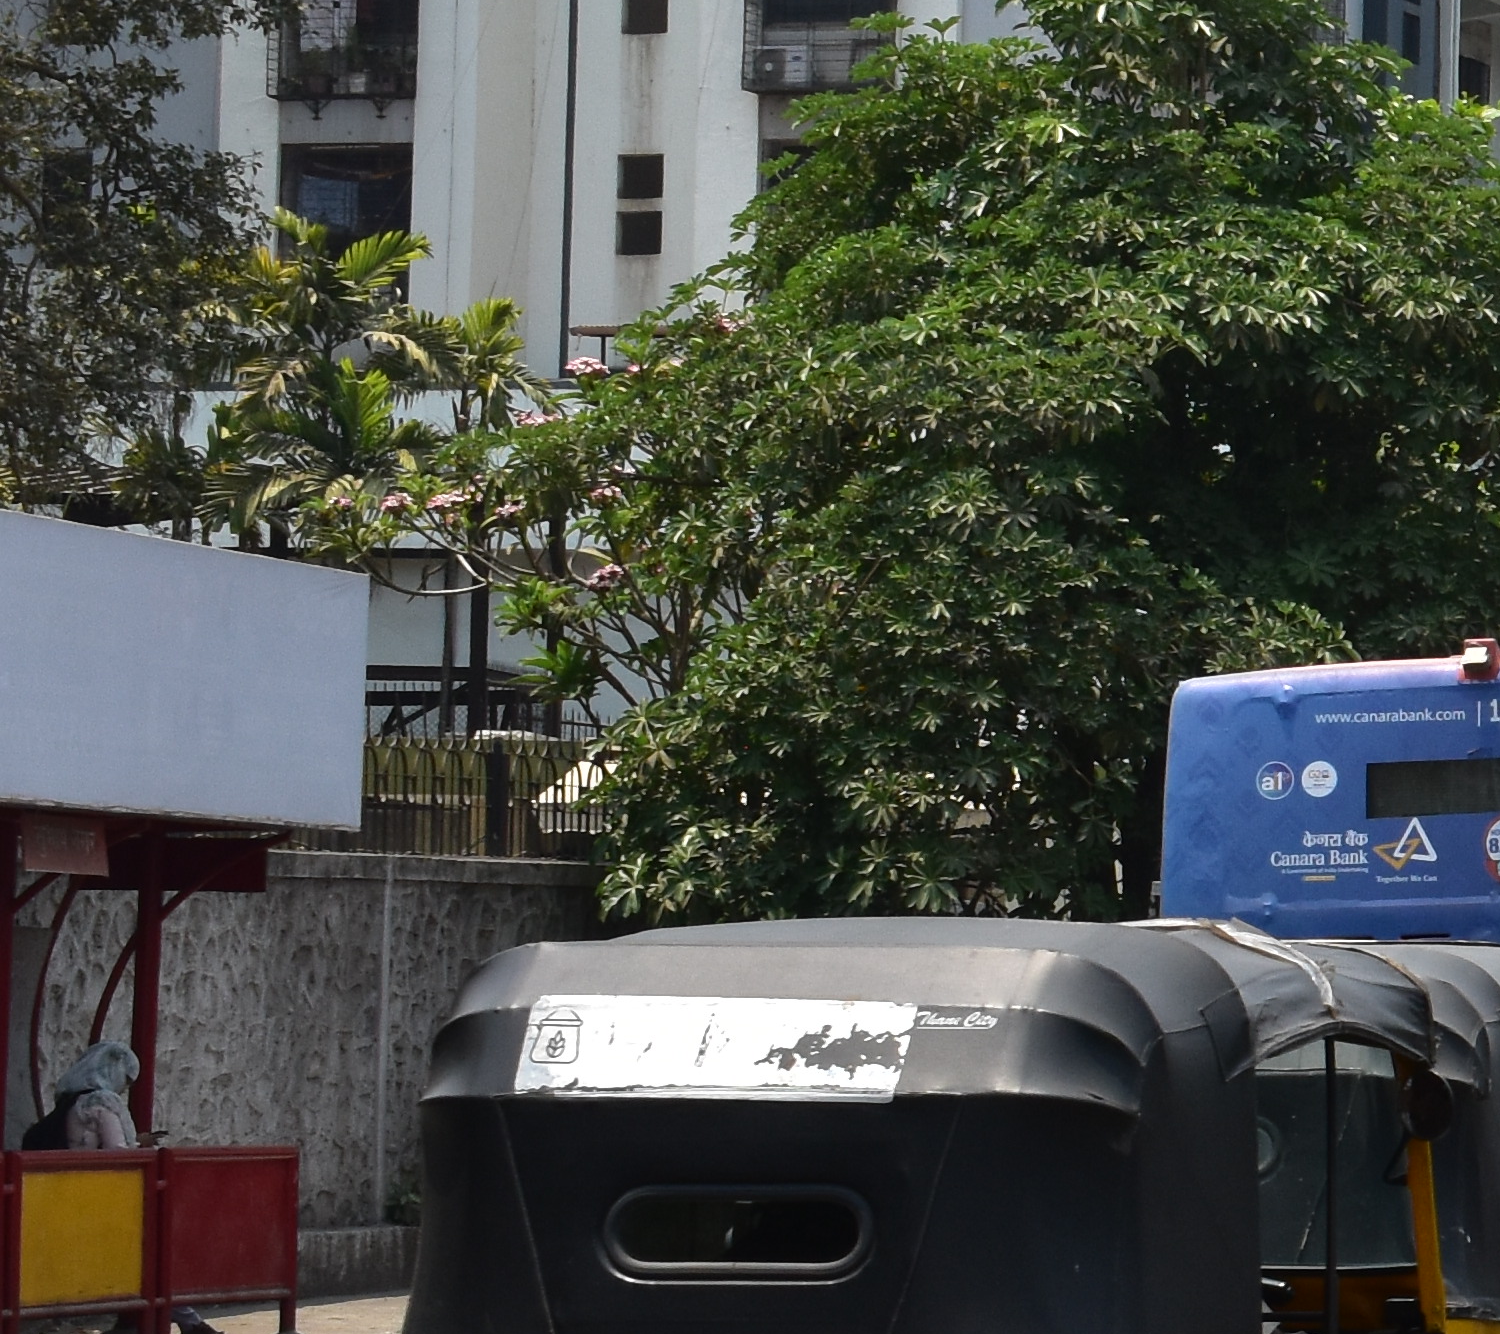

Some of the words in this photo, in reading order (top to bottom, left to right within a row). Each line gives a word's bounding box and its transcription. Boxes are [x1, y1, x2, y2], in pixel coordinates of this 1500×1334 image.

[1315, 708, 1466, 723] www.canarabank.com
[1489, 699, 1500, 722] 1
[1270, 851, 1325, 867] Canara
[1329, 850, 1368, 865] Bank
[962, 1011, 998, 1028] City
